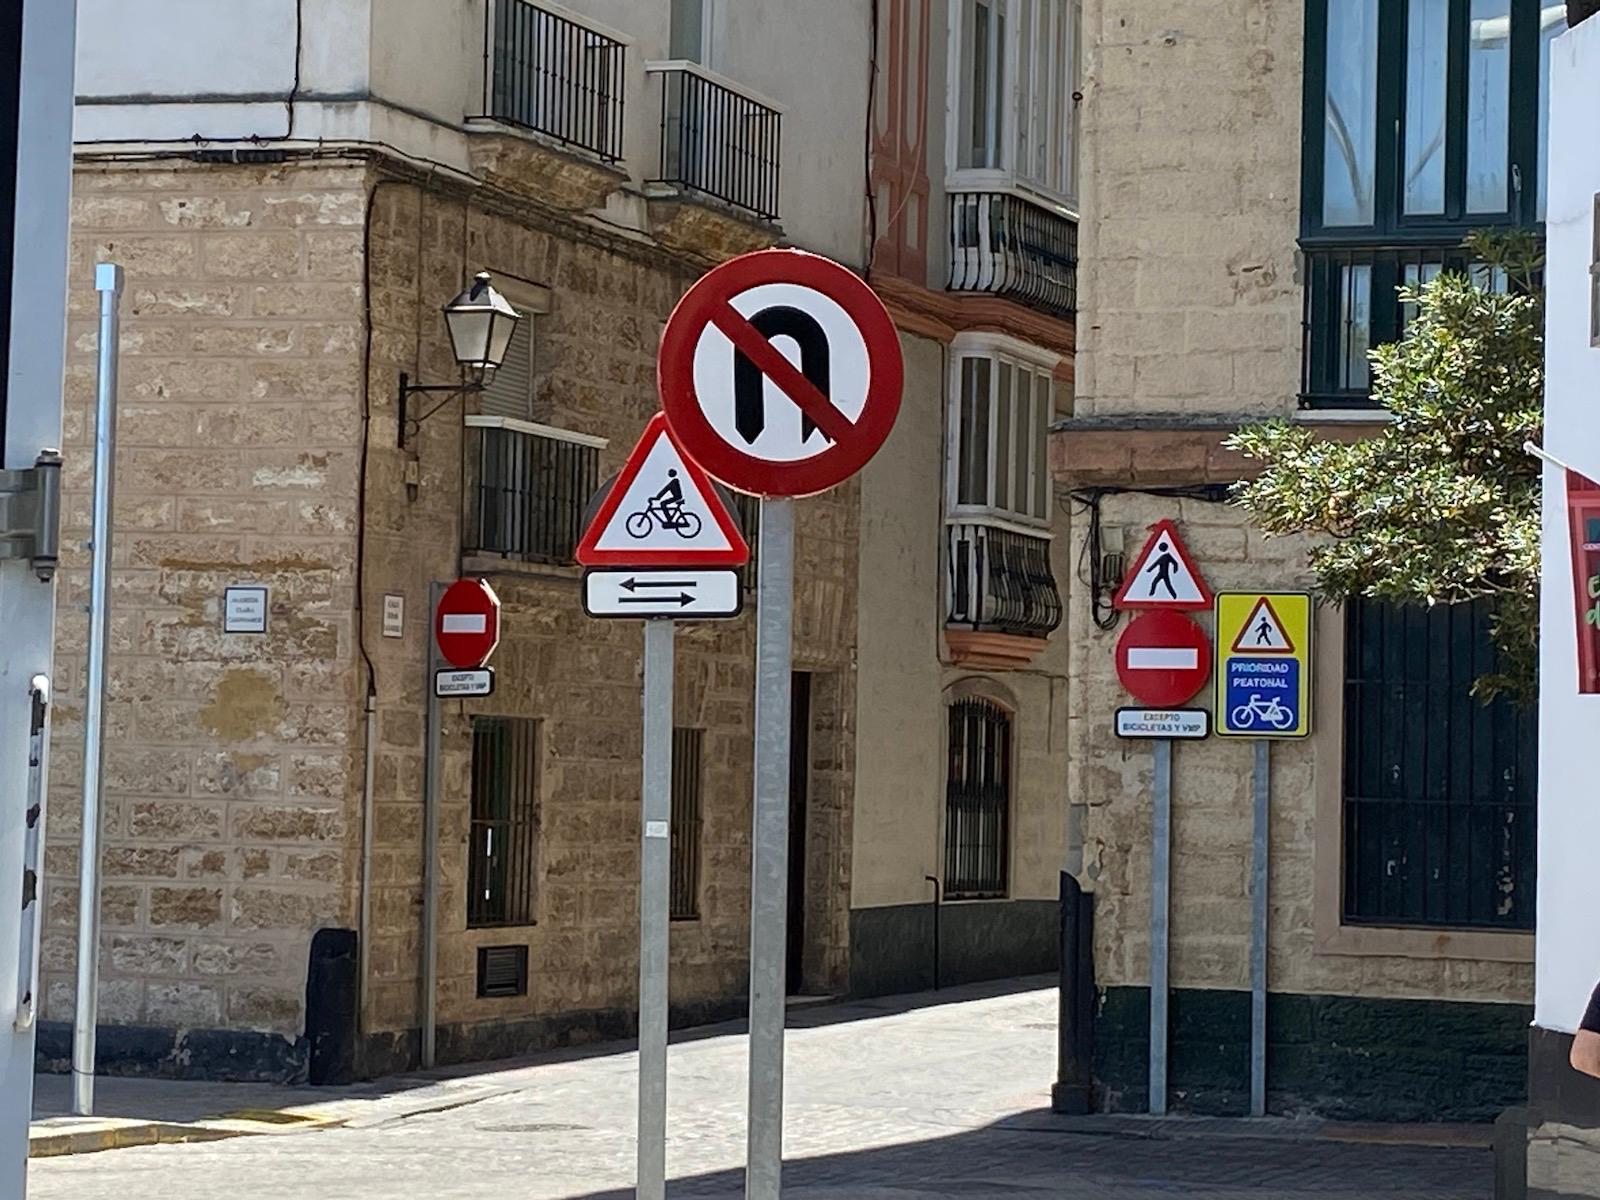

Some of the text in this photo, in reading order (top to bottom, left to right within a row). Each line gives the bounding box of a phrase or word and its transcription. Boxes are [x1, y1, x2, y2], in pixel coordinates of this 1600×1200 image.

[1231, 663, 1289, 673] PRIORIDAD
[1233, 678, 1288, 688] PEATONAL
[1143, 713, 1181, 721] EXCEPTO
[1122, 723, 1201, 733] BICICLETAS Y VMP
